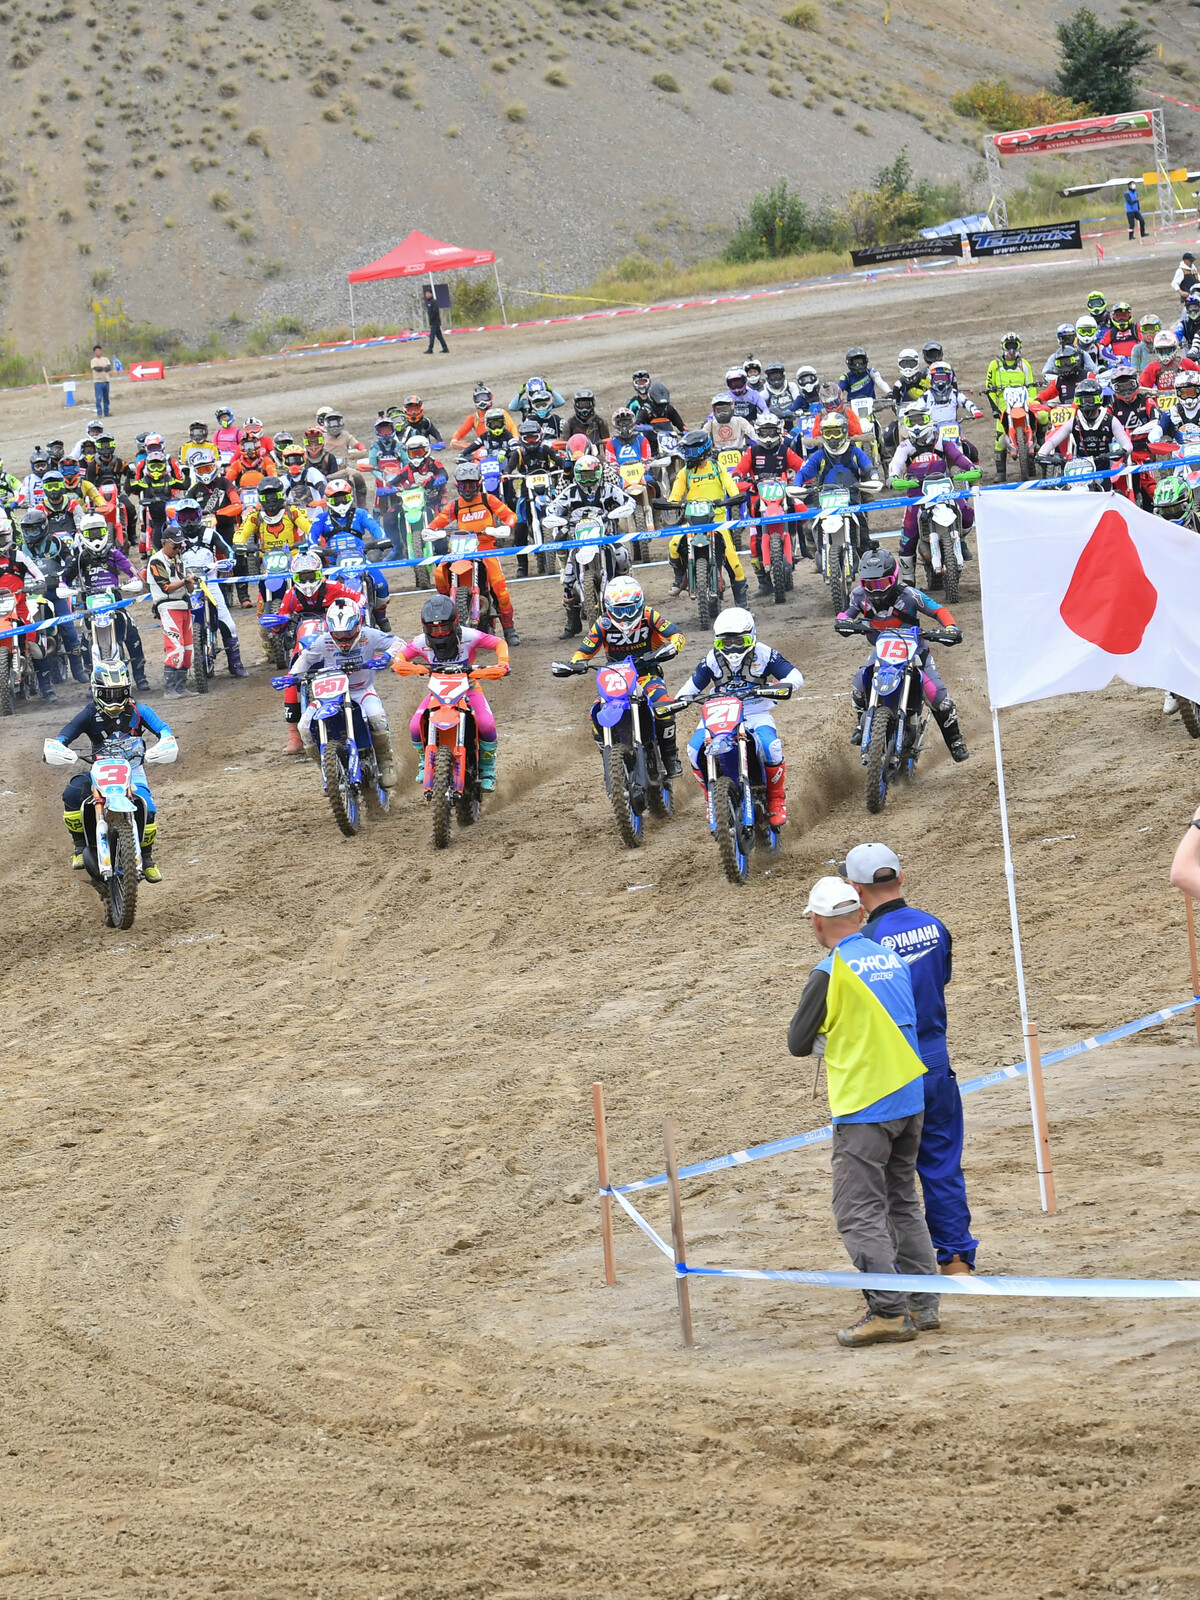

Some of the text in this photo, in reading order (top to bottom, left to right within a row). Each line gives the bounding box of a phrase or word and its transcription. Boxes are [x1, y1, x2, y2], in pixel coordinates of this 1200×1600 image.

[481, 461, 499, 474] 555
[722, 453, 739, 465] 395
[689, 503, 709, 515] 113
[266, 555, 288, 570] 149
[880, 641, 912, 659] 15
[315, 678, 346, 697] 557
[439, 681, 462, 696] 7
[605, 673, 629, 692] 25
[705, 703, 741, 727] 21
[97, 764, 128, 787] 3
[894, 924, 941, 948] YAMAHA
